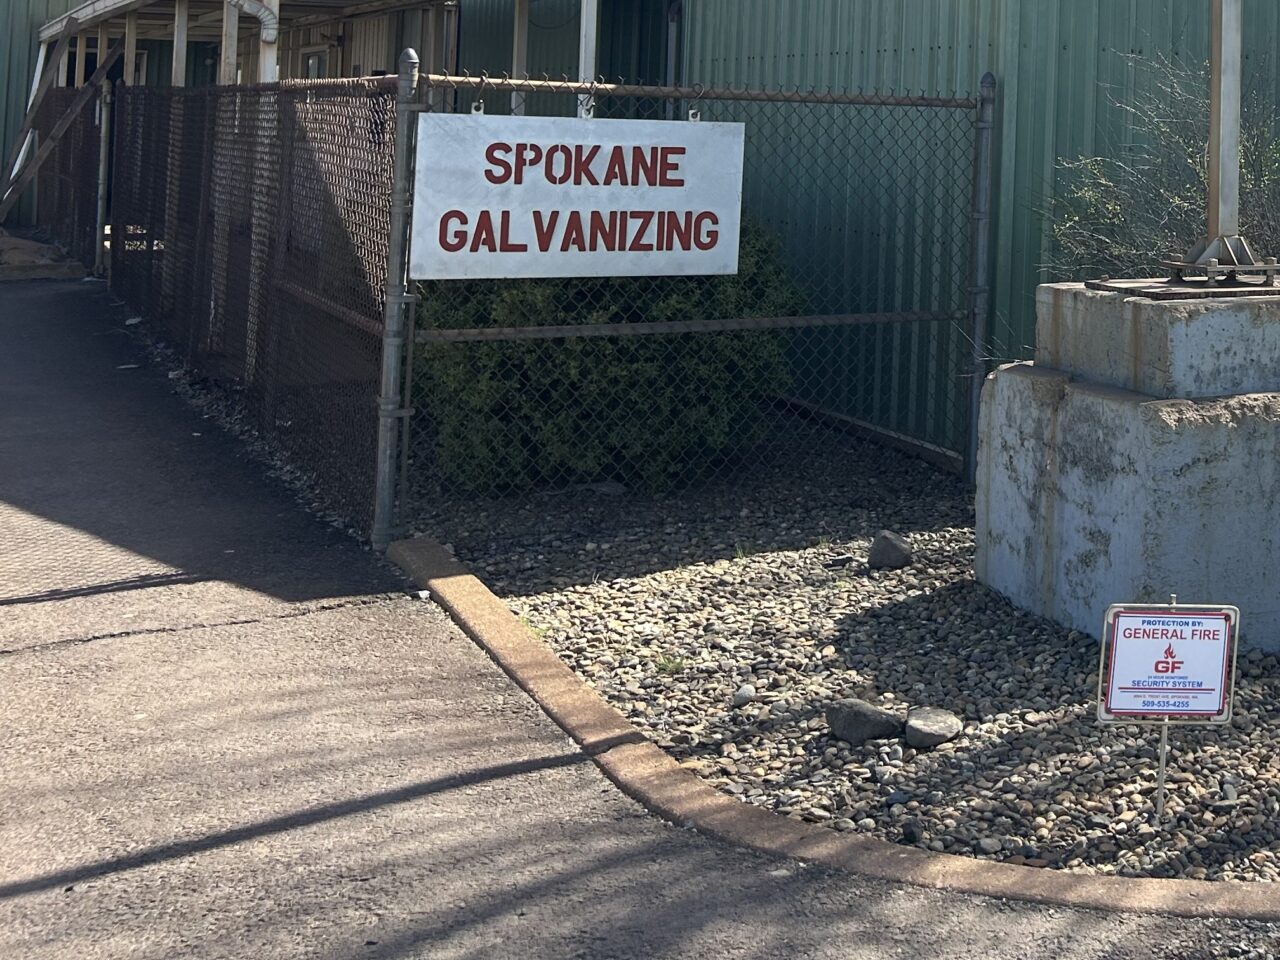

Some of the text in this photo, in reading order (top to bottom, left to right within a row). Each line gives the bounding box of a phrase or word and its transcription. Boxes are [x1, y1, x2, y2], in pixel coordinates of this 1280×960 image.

[484, 142, 686, 187] SPOKANE
[438, 209, 719, 253] GALVANIZING
[1141, 619, 1190, 627] PROTECTION
[1123, 627, 1221, 640] GENERAL FIRE
[1154, 660, 1184, 673] GF
[1131, 679, 1203, 688] SECURITY SYSTEM
[1141, 700, 1190, 708] 509-535-4255
